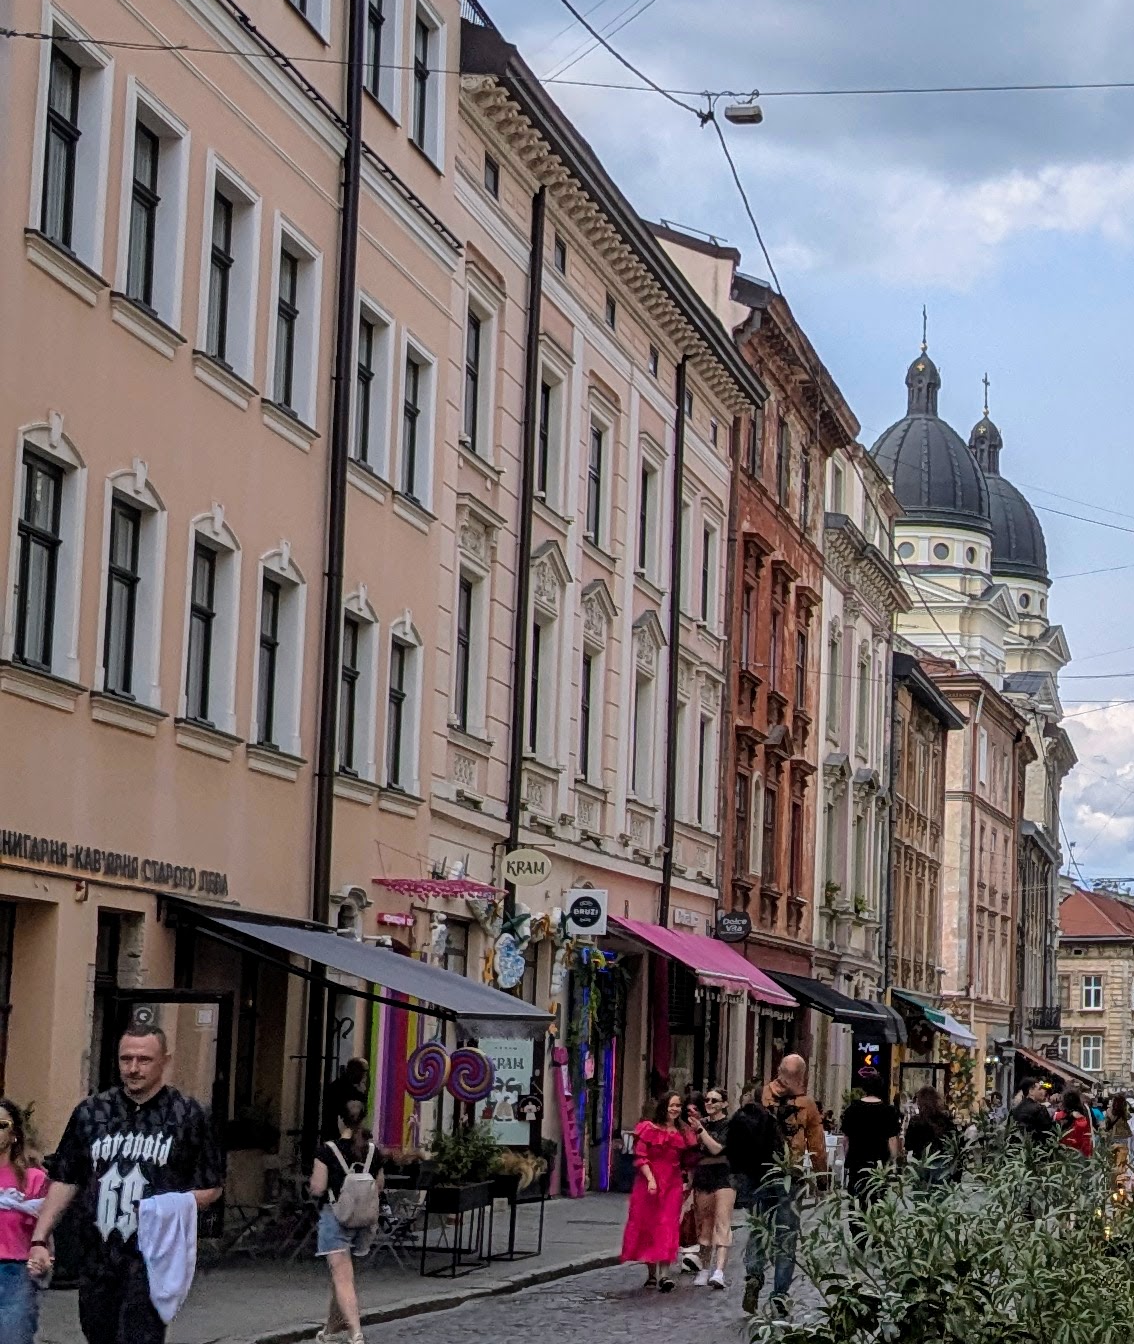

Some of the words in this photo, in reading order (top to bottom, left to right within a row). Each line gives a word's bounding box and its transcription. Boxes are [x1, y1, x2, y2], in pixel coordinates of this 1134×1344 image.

[0, 829, 138, 879] НИГАРНЯ-КАВ'ЯРНЯ
[141, 859, 196, 890] СТАРОГО
[507, 860, 544, 877] KRAM
[90, 1130, 173, 1171] paranoid
[93, 1161, 152, 1244] 69
